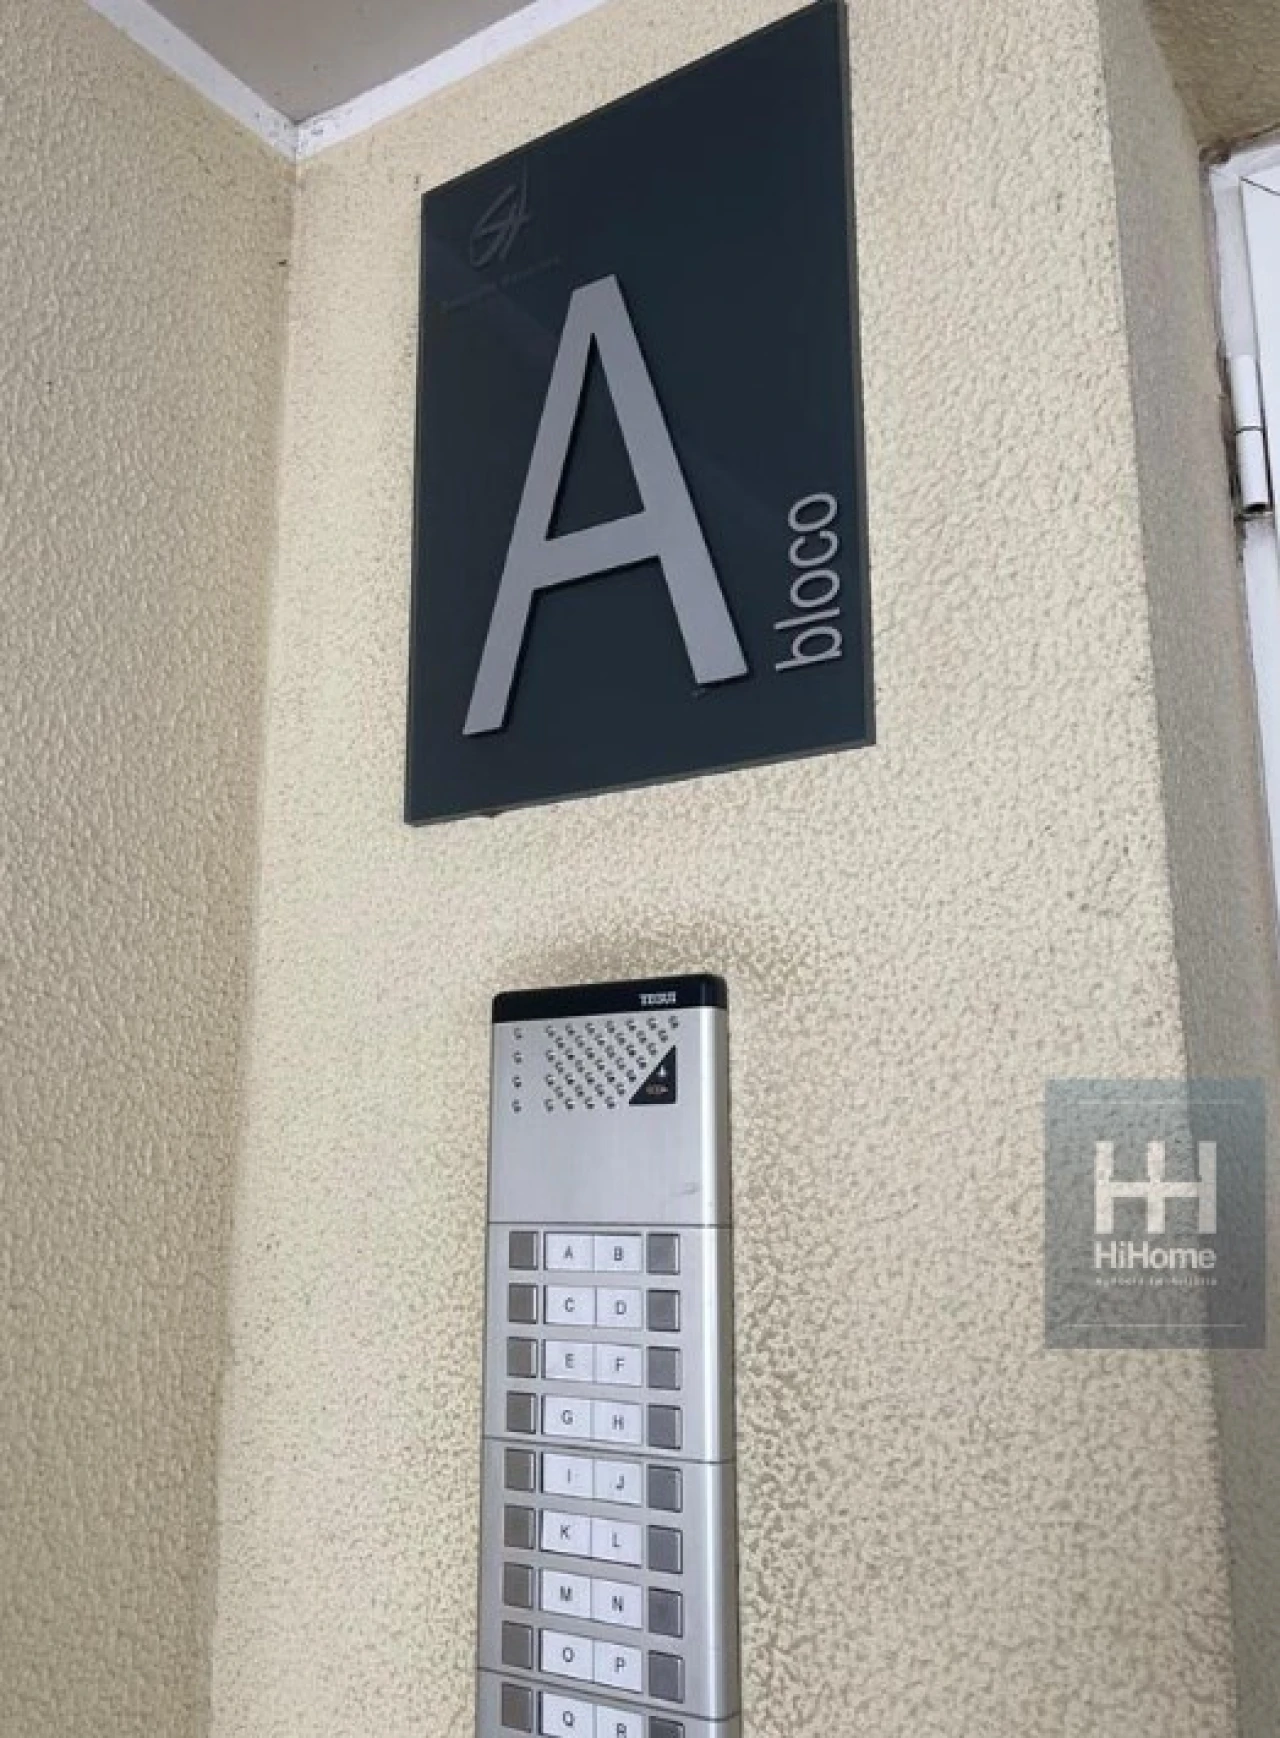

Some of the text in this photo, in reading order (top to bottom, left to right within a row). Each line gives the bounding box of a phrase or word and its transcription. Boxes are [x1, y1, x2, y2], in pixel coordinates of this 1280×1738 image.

[462, 274, 749, 736] A
[773, 492, 843, 672] bloco
[563, 1245, 574, 1260] A
[614, 1246, 624, 1262] B
[564, 1296, 576, 1313] C
[615, 1299, 627, 1316] D
[564, 1353, 575, 1369] E
[615, 1357, 625, 1372] F
[561, 1409, 573, 1425] G
[612, 1414, 625, 1431] H
[616, 1474, 625, 1490] J
[560, 1524, 571, 1541] K
[611, 1532, 621, 1548] L
[611, 1594, 624, 1613] N
[562, 1646, 575, 1663] O
[614, 1655, 626, 1673] P
[562, 1710, 575, 1728] Q
